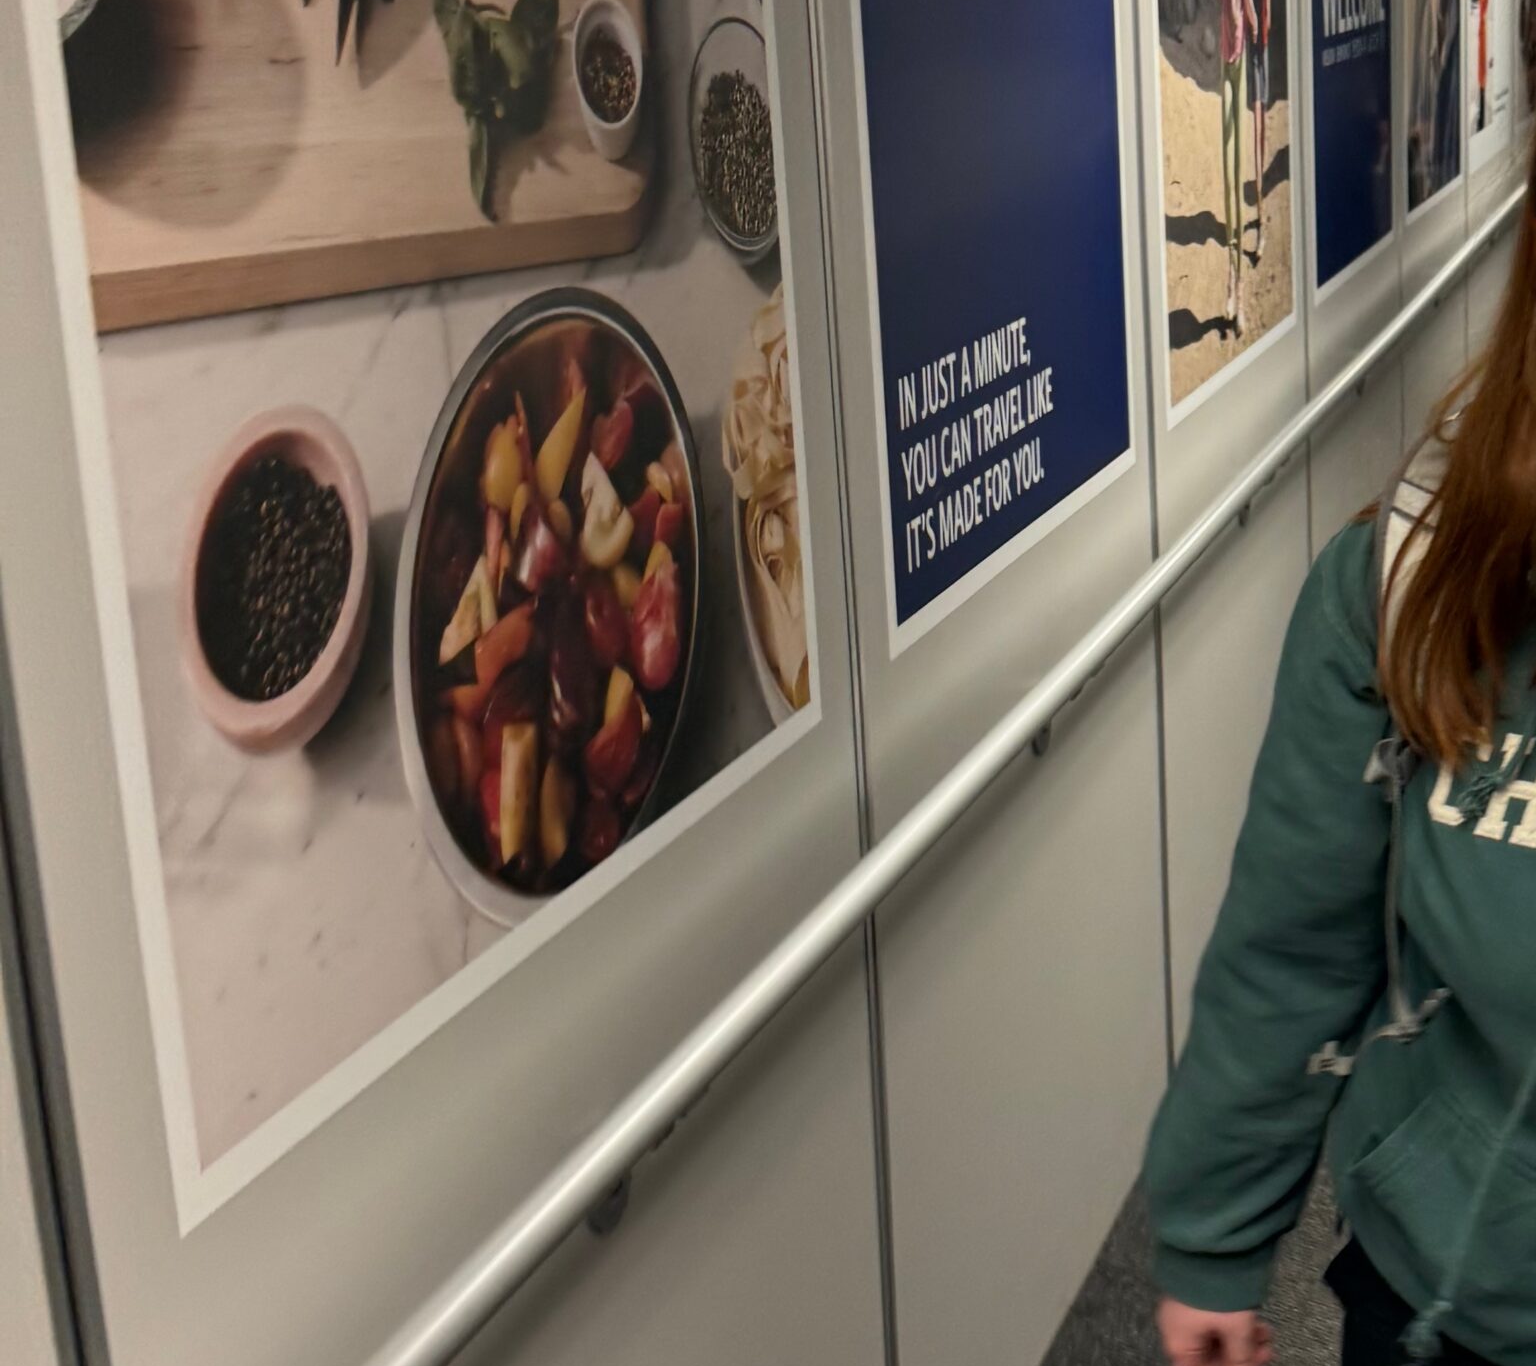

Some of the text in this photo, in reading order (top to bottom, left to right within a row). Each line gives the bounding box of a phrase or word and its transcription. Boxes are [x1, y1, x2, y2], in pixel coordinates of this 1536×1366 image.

[899, 317, 1031, 430] IN JUST A MINUTE,
[902, 367, 1053, 501] YOU CAN TRAVEL LIKE
[906, 437, 1044, 573] IT'S MADE FOR YOU.
